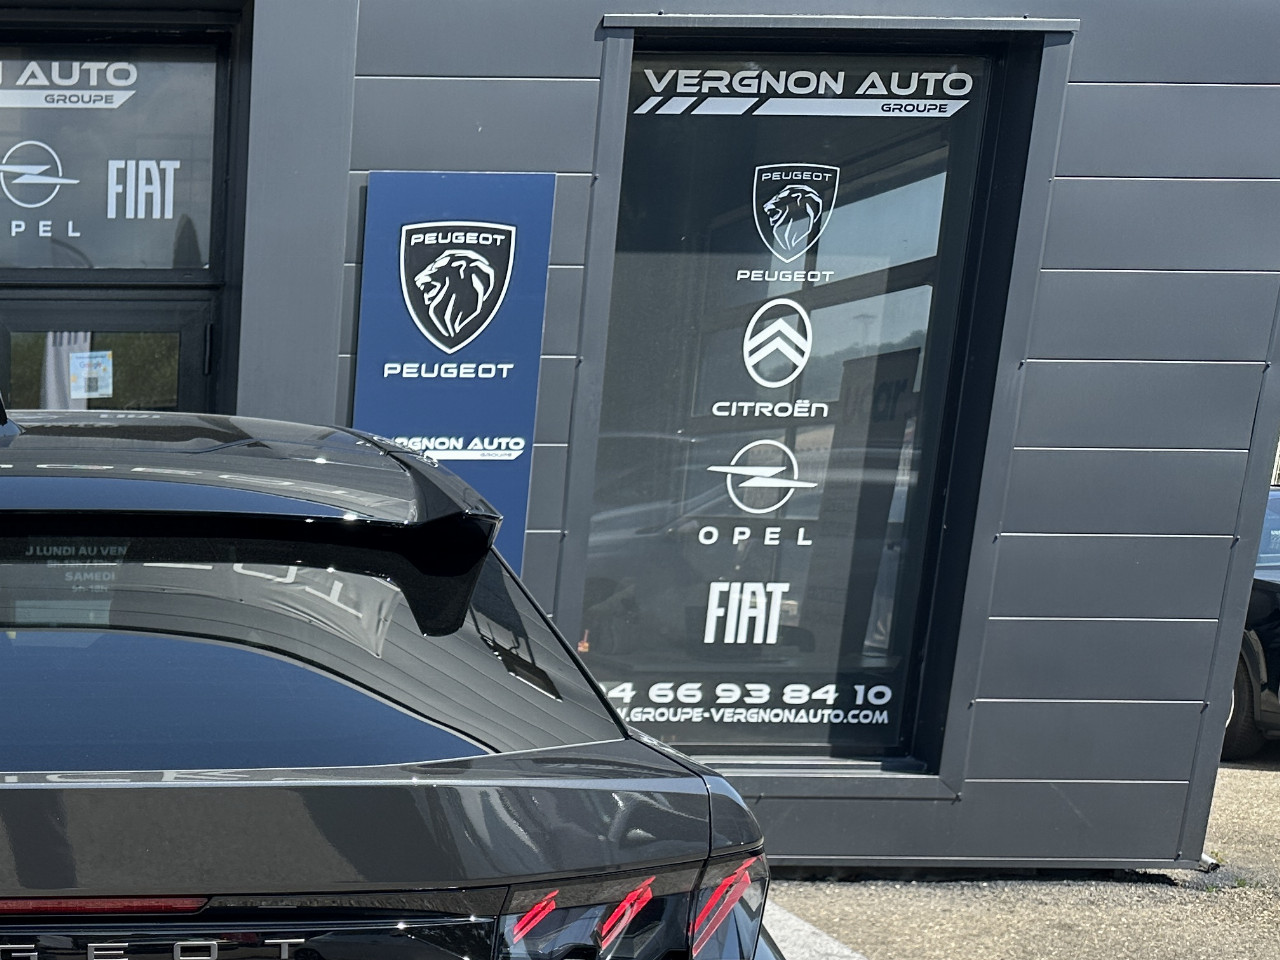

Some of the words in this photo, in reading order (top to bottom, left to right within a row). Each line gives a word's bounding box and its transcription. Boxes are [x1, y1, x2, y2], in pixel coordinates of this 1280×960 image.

[15, 61, 138, 87] AUTO
[643, 69, 845, 95] VERGNON
[855, 71, 974, 96] AUTO
[44, 94, 114, 105] GROUPE
[880, 103, 948, 113] GROUPE
[761, 172, 832, 182] PEUGEOT
[107, 160, 180, 219] FIAT
[410, 232, 506, 246] PEUGEOT
[737, 270, 834, 282] PEUGEOT
[383, 362, 514, 378] PEUGEOT
[467, 437, 526, 450] AUTO
[698, 526, 813, 546] OPEL
[36, 545, 75, 556] LUNDI
[78, 545, 98, 556] AU
[64, 571, 115, 582] SAMEDI
[703, 582, 789, 644] FIAT
[599, 682, 637, 704] 4
[648, 682, 703, 704] 66
[715, 683, 771, 705] 93
[782, 683, 839, 705] 84
[853, 684, 892, 706] 10
